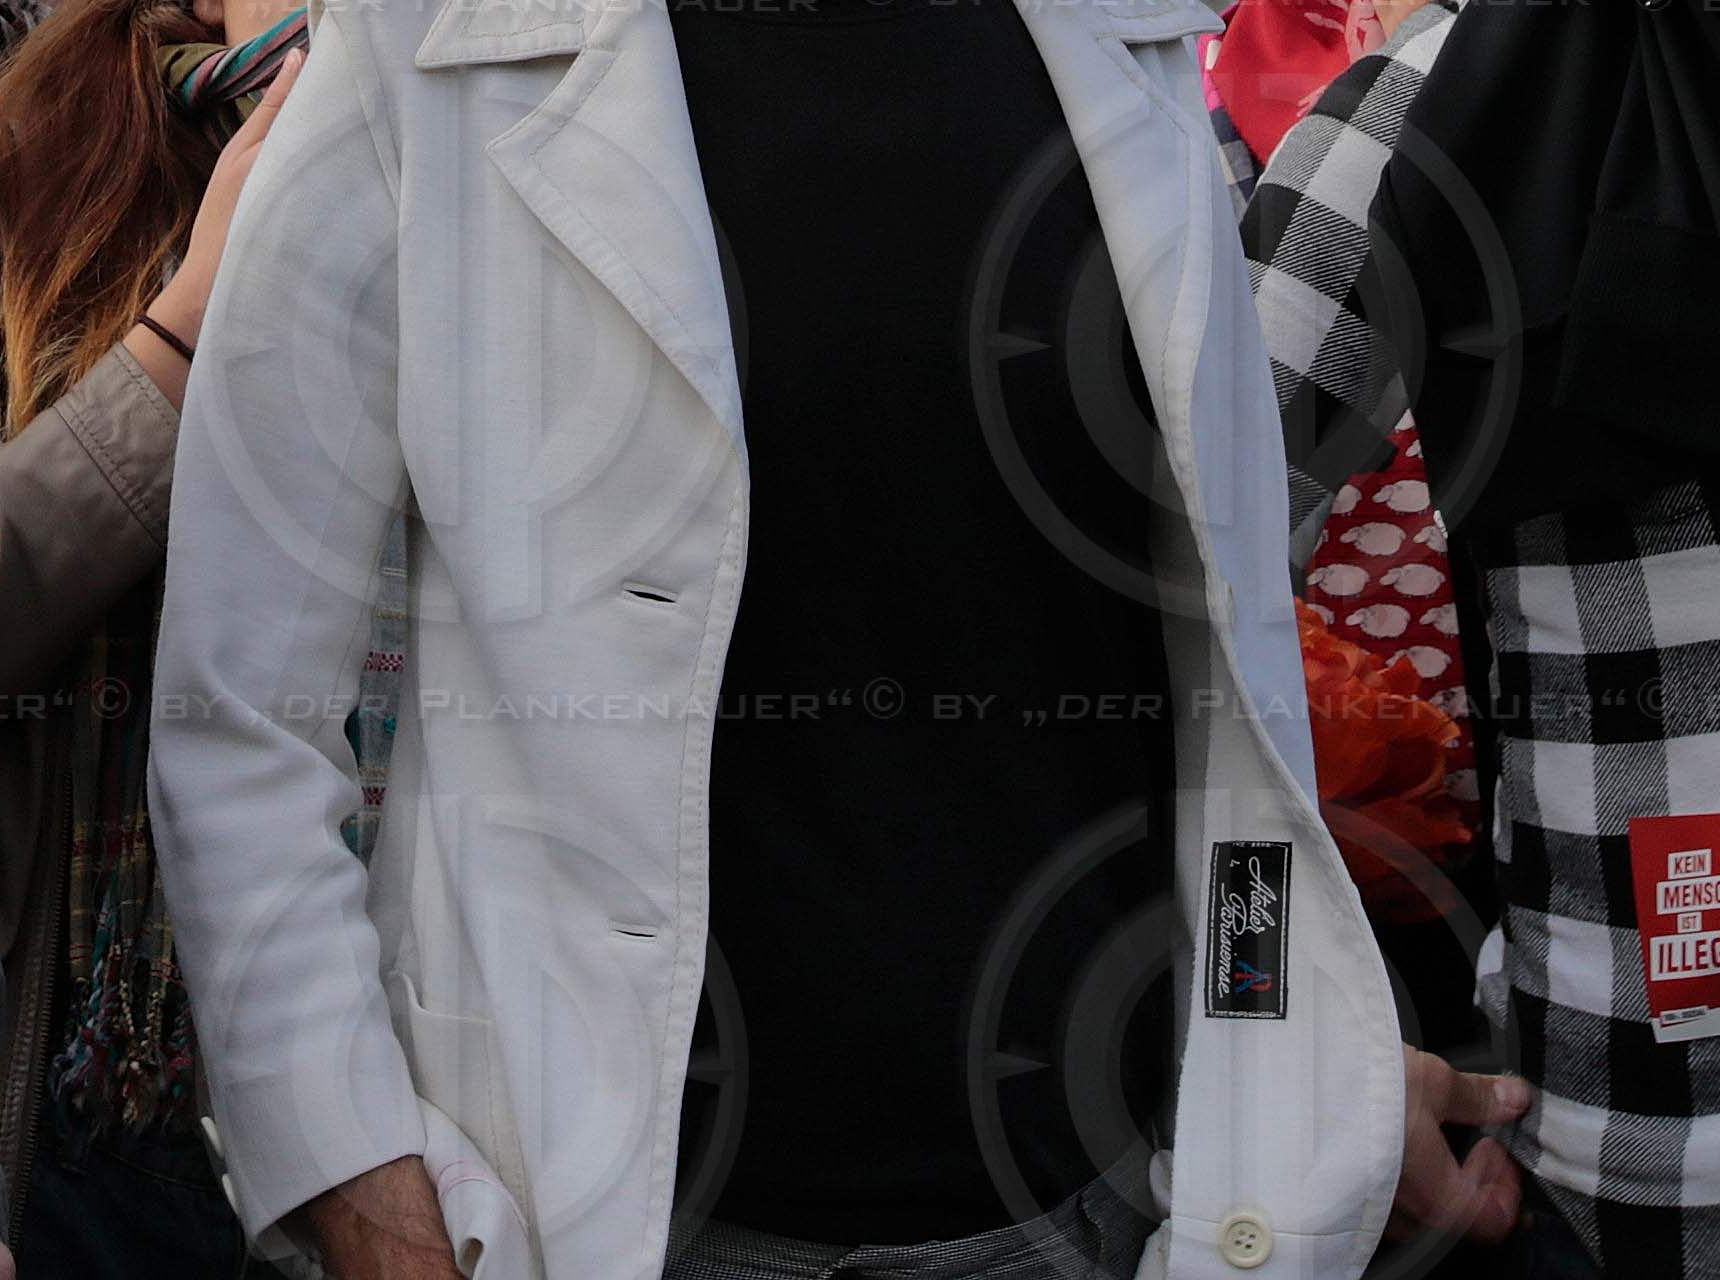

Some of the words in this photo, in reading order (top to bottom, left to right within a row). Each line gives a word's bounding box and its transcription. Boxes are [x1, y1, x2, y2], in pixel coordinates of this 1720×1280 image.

[1673, 853, 1706, 875] KEIN
[1248, 855, 1278, 935] Atelier
[1681, 915, 1698, 930] IST
